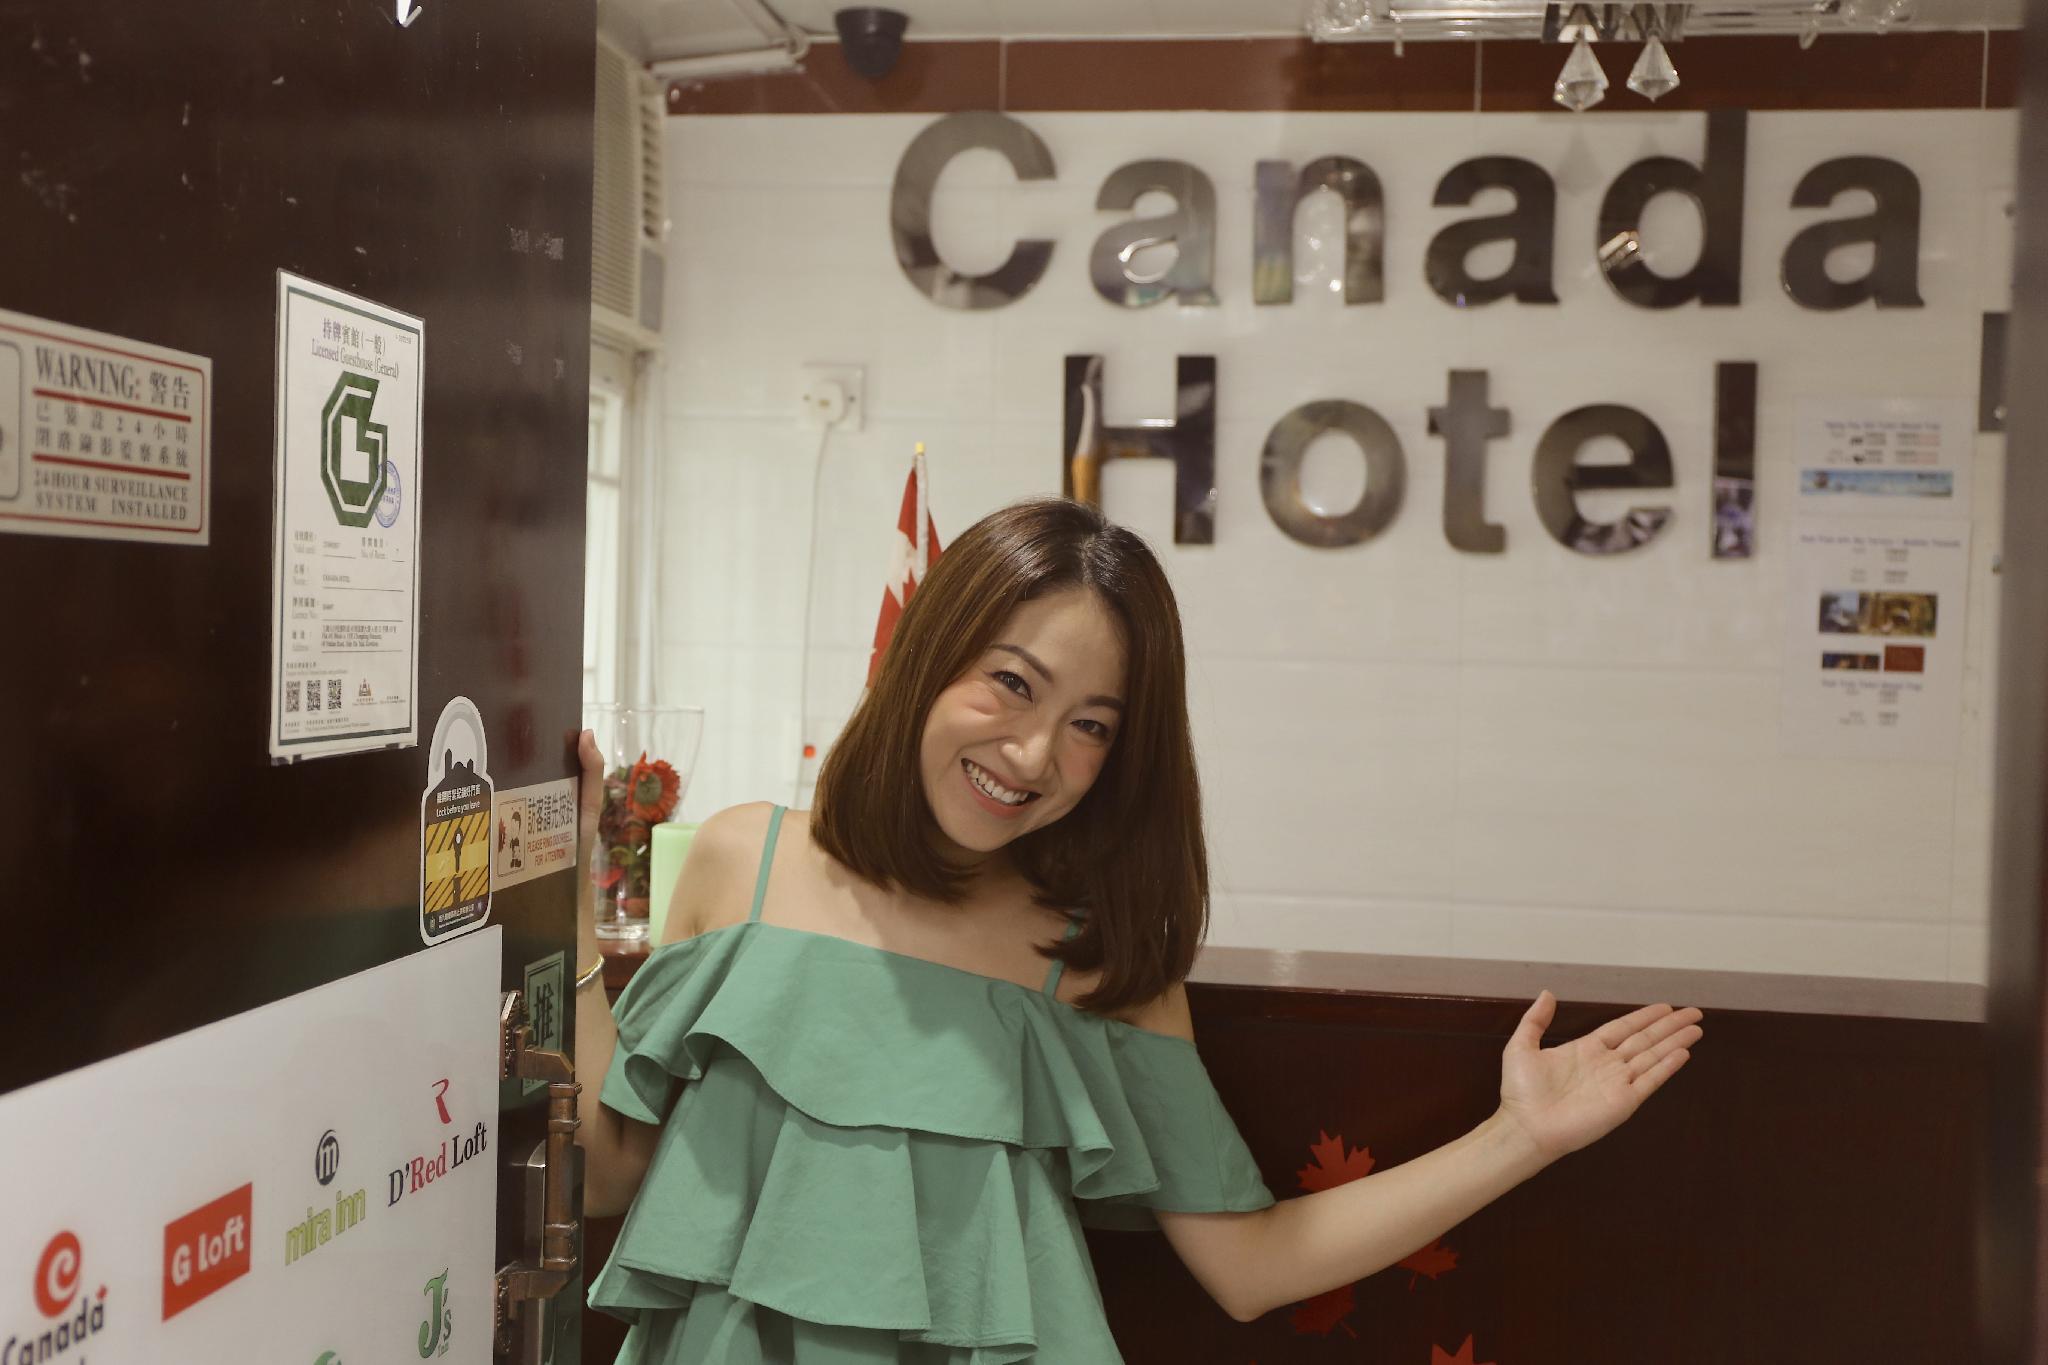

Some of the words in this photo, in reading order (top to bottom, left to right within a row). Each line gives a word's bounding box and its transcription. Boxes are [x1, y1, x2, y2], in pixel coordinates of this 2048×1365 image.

[890, 108, 1925, 311] Canada
[35, 346, 140, 400] WARNING:
[312, 338, 339, 362] Licensed
[341, 347, 373, 371] Guesthouse
[1063, 354, 1758, 561] Hotel
[36, 491, 97, 512] SYSTEM
[112, 499, 187, 520] INSTALLED
[94, 475, 188, 503] SURVEILLANCE
[436, 807, 447, 818] Lock
[447, 804, 461, 815] before
[461, 804, 469, 814] you
[527, 839, 543, 853] PLEASE
[535, 854, 544, 867] FOR
[545, 848, 566, 863] ATTENTION
[388, 1142, 447, 1207] D'Red
[452, 1121, 487, 1169] Loft
[171, 1244, 191, 1286] G
[199, 1215, 244, 1272] loft
[285, 1206, 332, 1266] mira
[336, 1190, 366, 1236] inn
[2, 1297, 106, 1365] Canada
